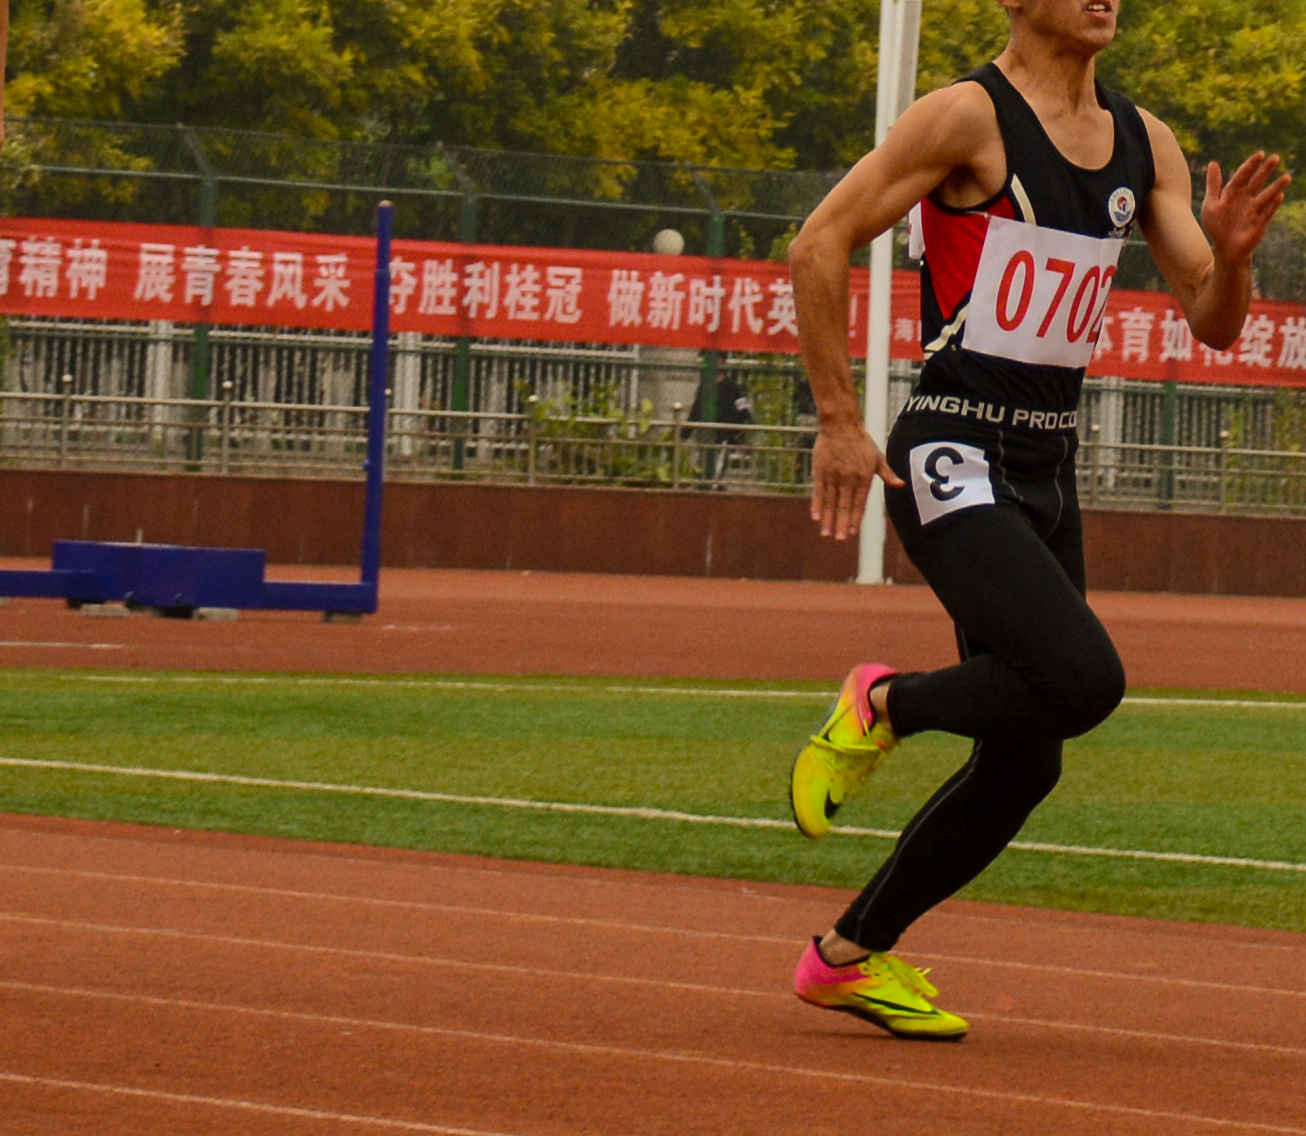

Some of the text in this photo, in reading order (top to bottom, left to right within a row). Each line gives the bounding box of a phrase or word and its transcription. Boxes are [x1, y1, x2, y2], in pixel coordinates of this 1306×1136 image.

[133, 243, 351, 312] 展青春风采
[387, 255, 584, 325] 夺胜利桂冠
[905, 394, 1006, 424] YINGHU
